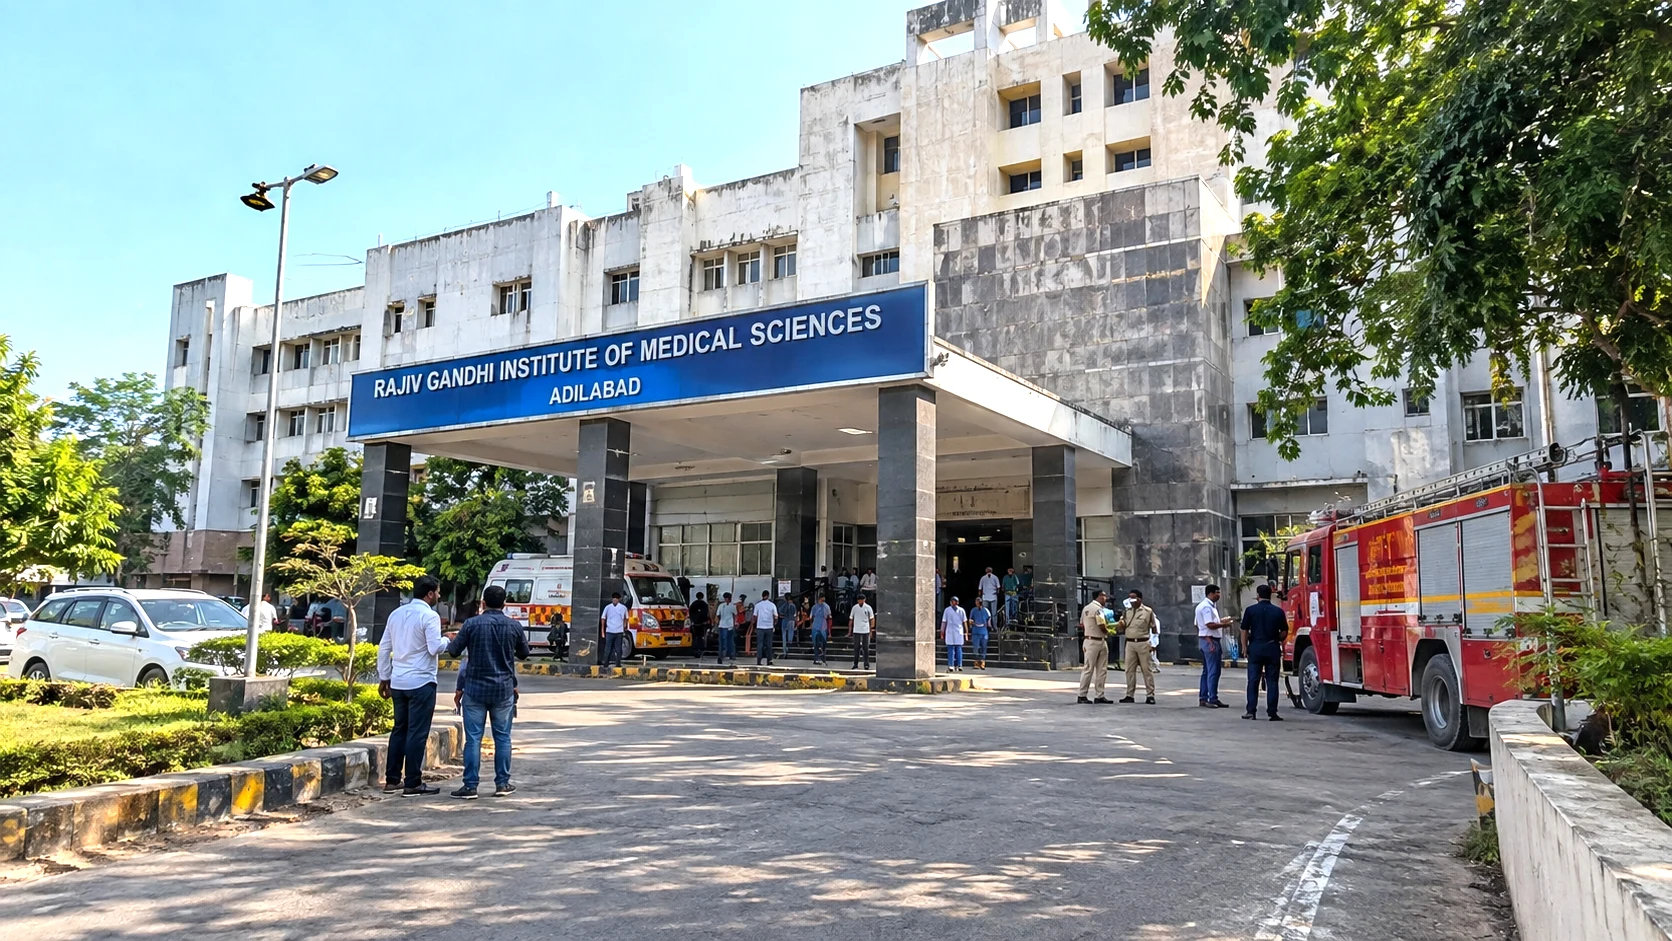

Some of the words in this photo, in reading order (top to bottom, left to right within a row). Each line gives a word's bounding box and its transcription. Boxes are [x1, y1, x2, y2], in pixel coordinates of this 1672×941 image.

[373, 373, 423, 398] RAJIV
[426, 362, 495, 391] GANDHI
[499, 346, 598, 381] INSTITUTE
[604, 341, 634, 367] OF
[640, 326, 742, 361] MEDICAL
[750, 304, 882, 346] SCIENCES
[548, 376, 641, 405] ADILABAD
